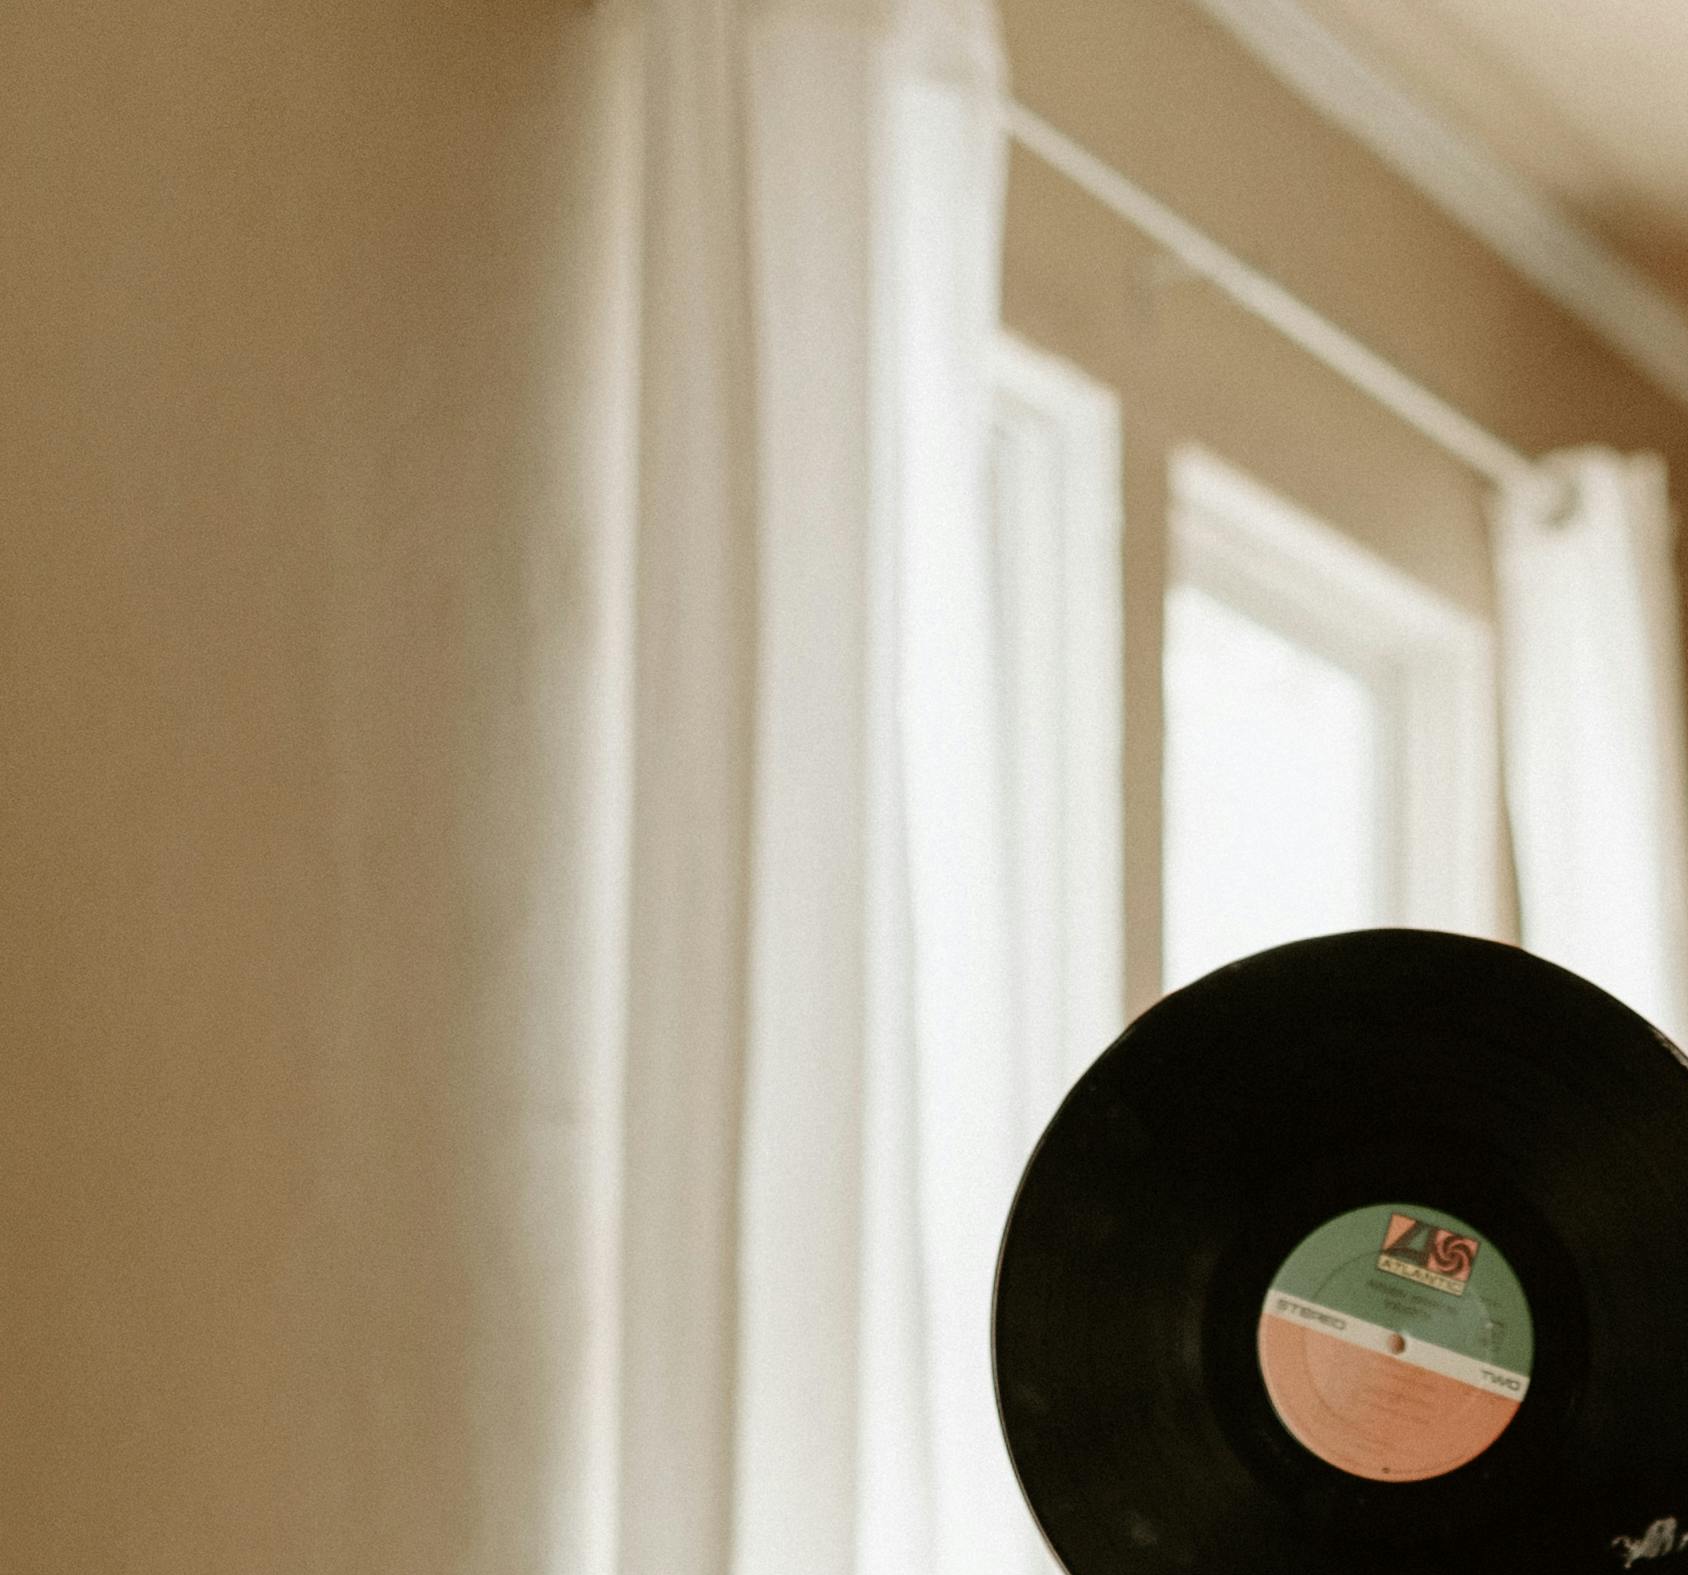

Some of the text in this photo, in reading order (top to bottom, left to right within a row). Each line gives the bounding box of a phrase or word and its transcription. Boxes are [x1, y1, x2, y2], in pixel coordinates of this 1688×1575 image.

[1380, 1258, 1464, 1293] ATLANTIC
[1275, 1299, 1346, 1331] STEREO
[1481, 1369, 1522, 1393] TWO
